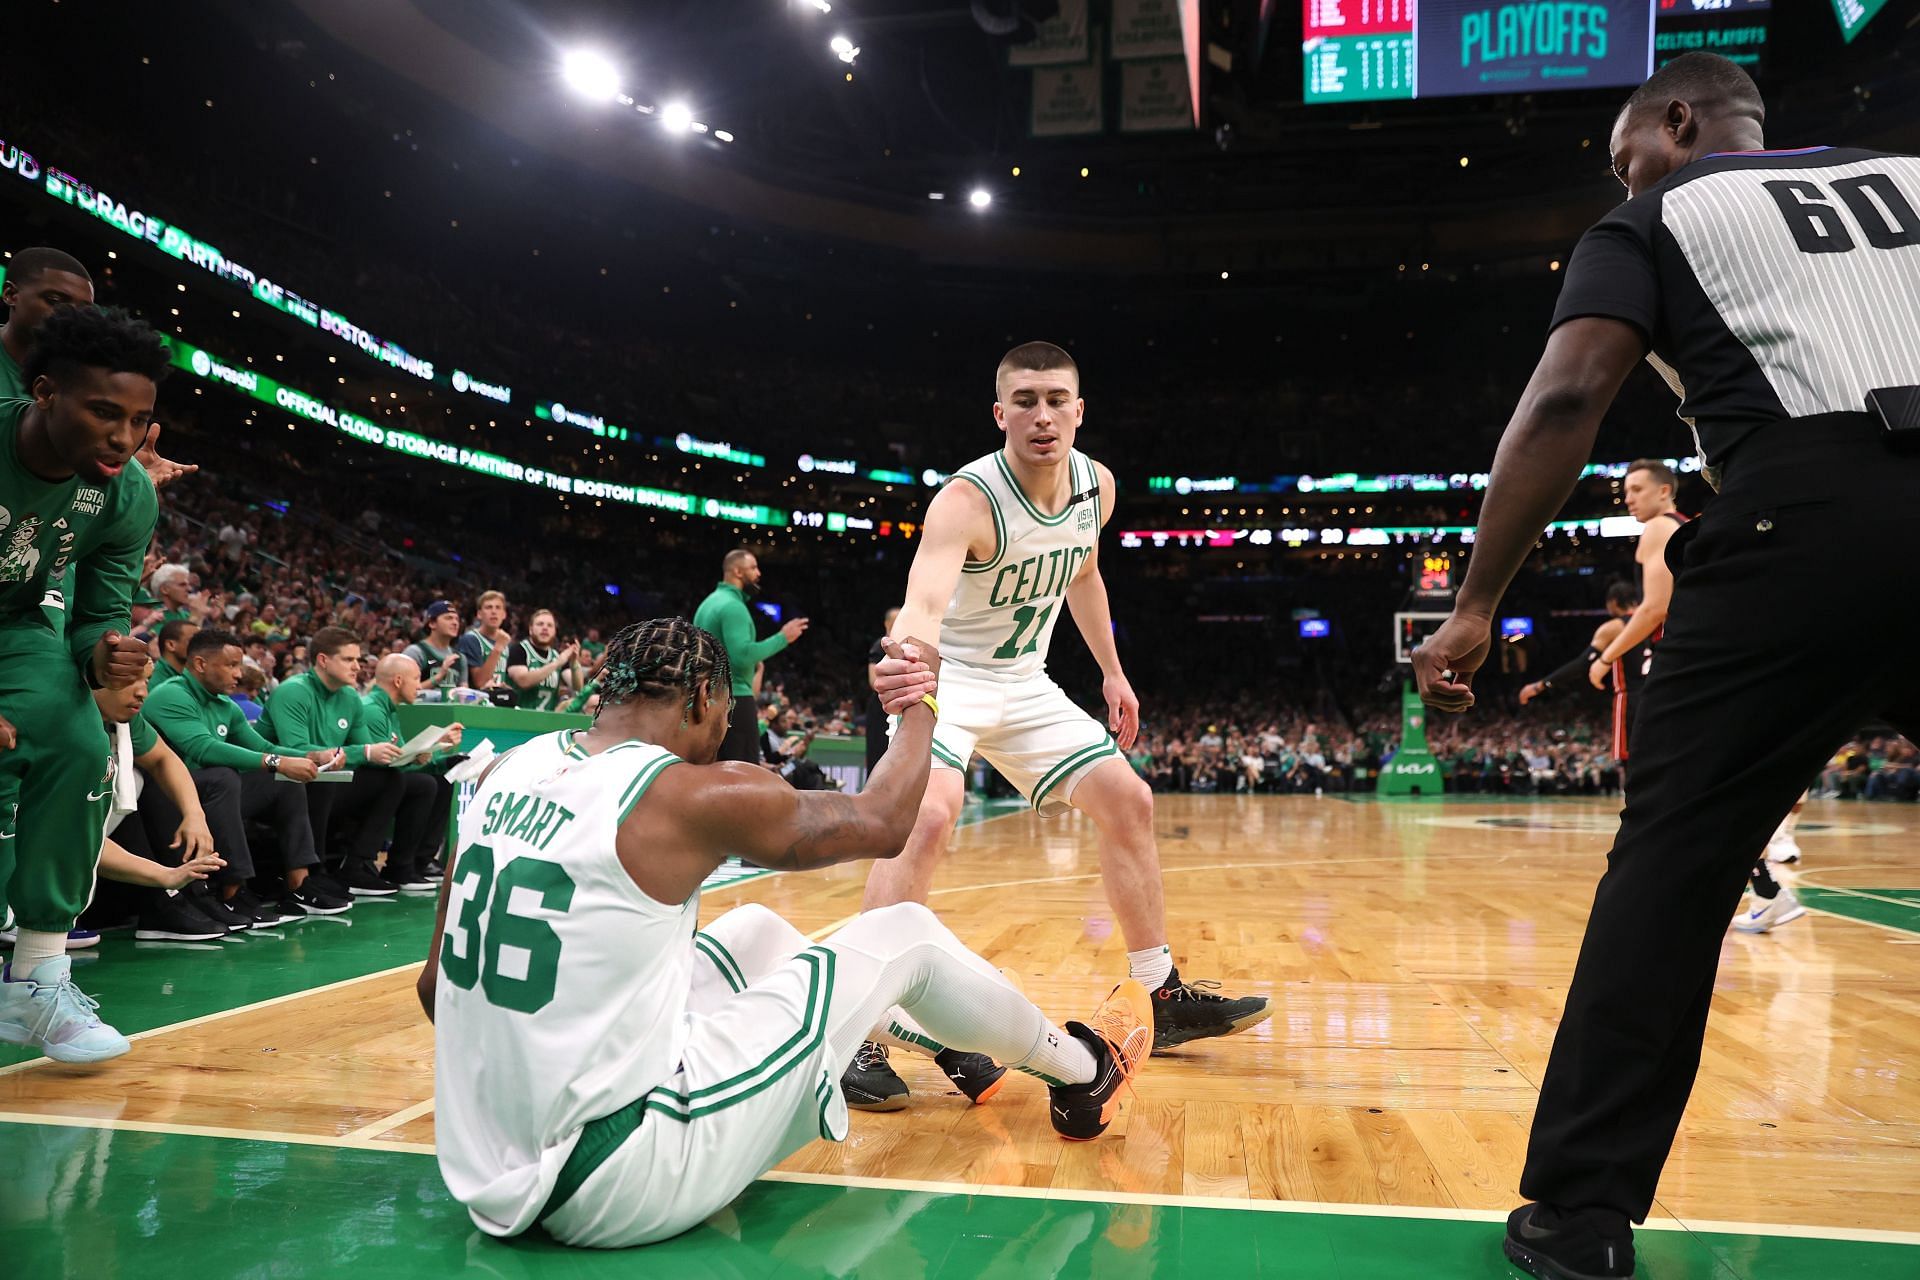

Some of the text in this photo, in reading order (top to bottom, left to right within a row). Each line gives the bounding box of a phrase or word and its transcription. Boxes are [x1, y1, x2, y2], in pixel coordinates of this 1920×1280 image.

[1461, 3, 1608, 67] PLAYOFFS
[1656, 26, 1766, 50] CELTICS PLAYOFFS
[1762, 173, 1920, 254] 60
[46, 166, 160, 244] STORAGE
[164, 226, 256, 290] PARTNER
[258, 278, 285, 304] OF
[320, 309, 380, 357] BOSTON
[381, 339, 434, 380] BRUINS
[469, 379, 511, 403] wasabi
[211, 360, 689, 511] wasabi OFFICIAL CLOUD STORAGE PARTNER OF THE BOSTON BRUINS
[71, 500, 104, 516] PRINT
[76, 488, 105, 504] VISTA
[1077, 508, 1094, 522] VISTA
[52, 517, 75, 568] PRID
[1077, 519, 1094, 533] PRINT
[992, 601, 1054, 659] 11
[482, 792, 576, 851] SMART
[440, 843, 577, 1015] 36
